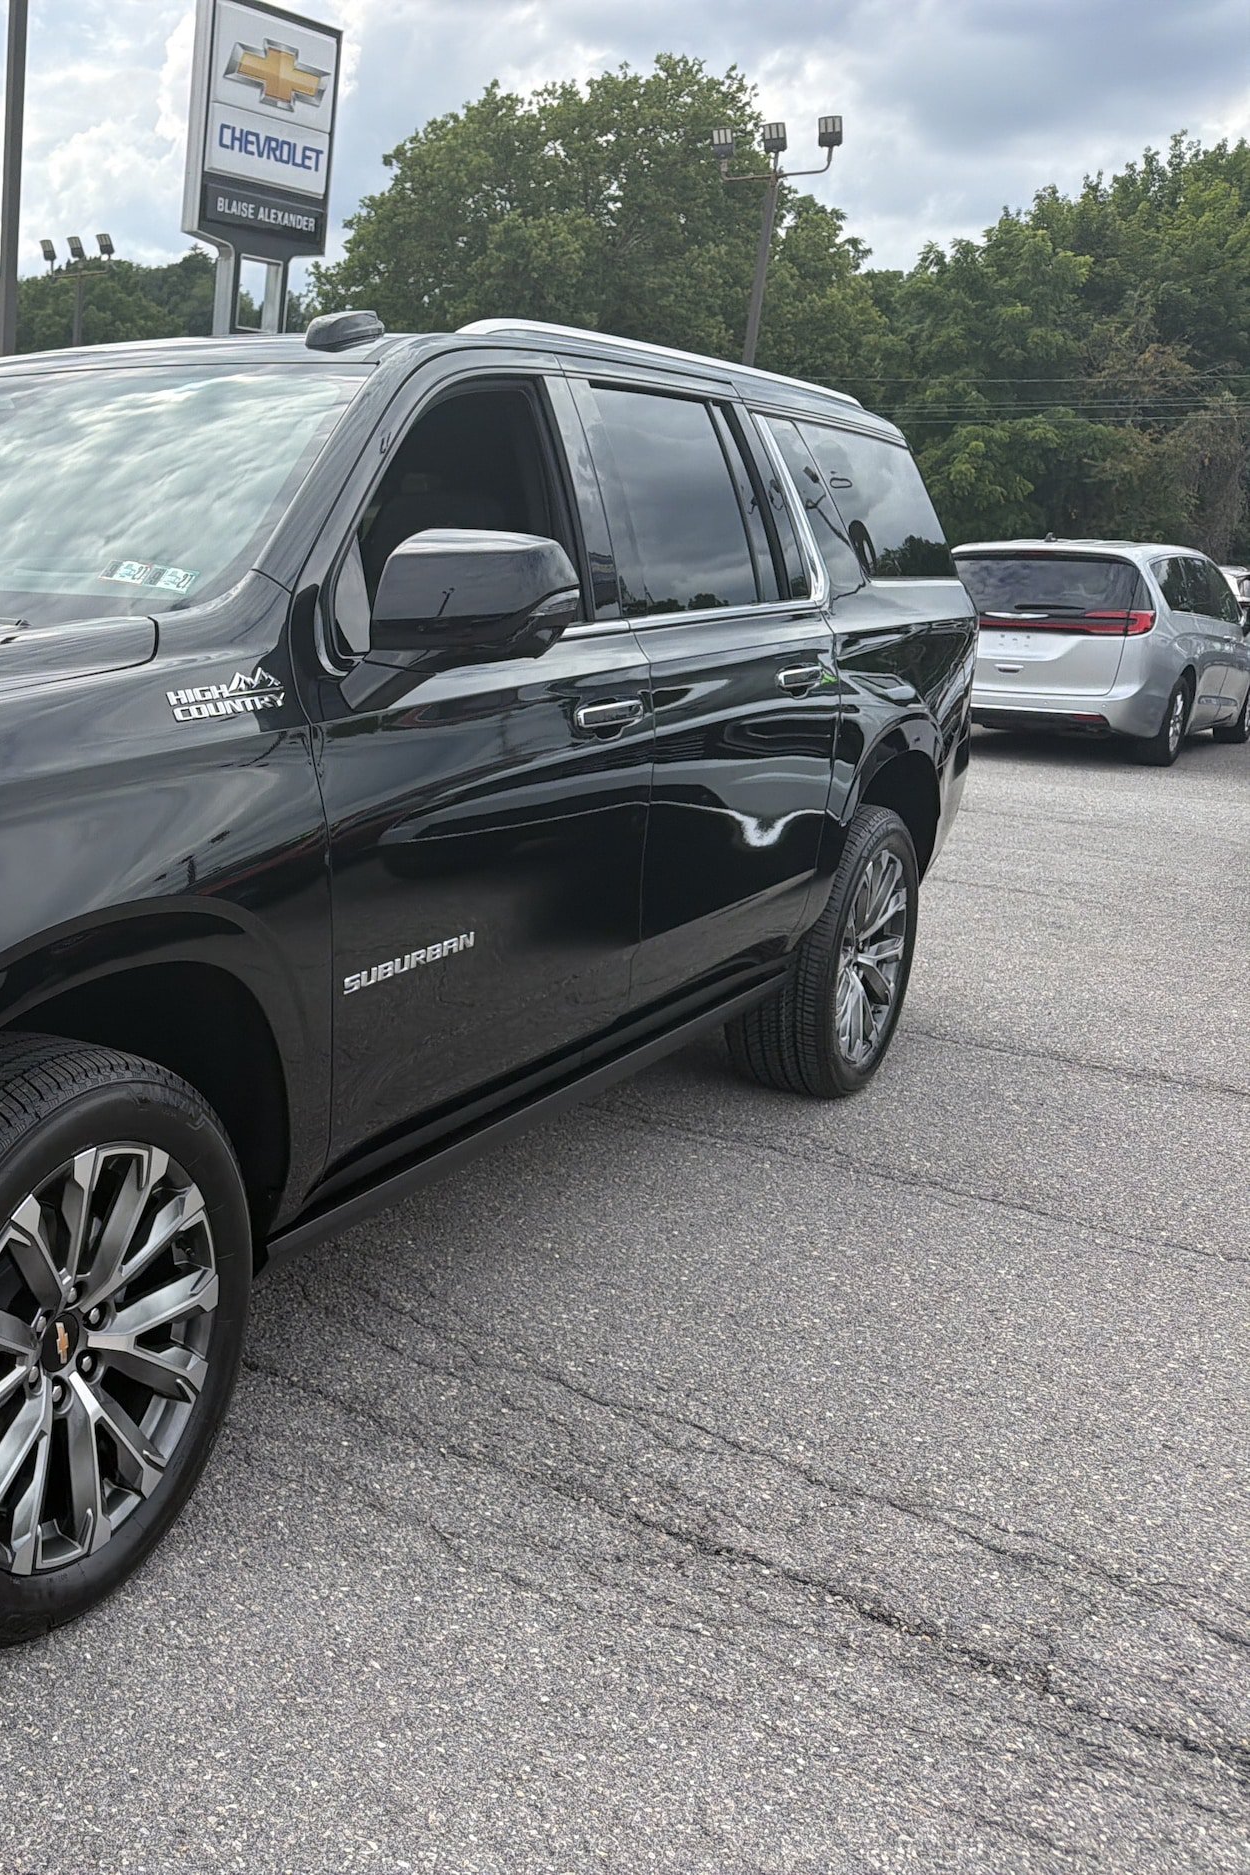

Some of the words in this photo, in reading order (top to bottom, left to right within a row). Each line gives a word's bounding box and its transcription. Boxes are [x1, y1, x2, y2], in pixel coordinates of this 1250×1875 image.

[218, 123, 324, 172] CHEVROLET
[216, 196, 256, 219] BLAISE
[257, 206, 316, 232] ALEXANDER
[166, 684, 229, 706] HIGH
[173, 692, 285, 723] COUNTRY
[343, 931, 476, 996] SUBURBAN
